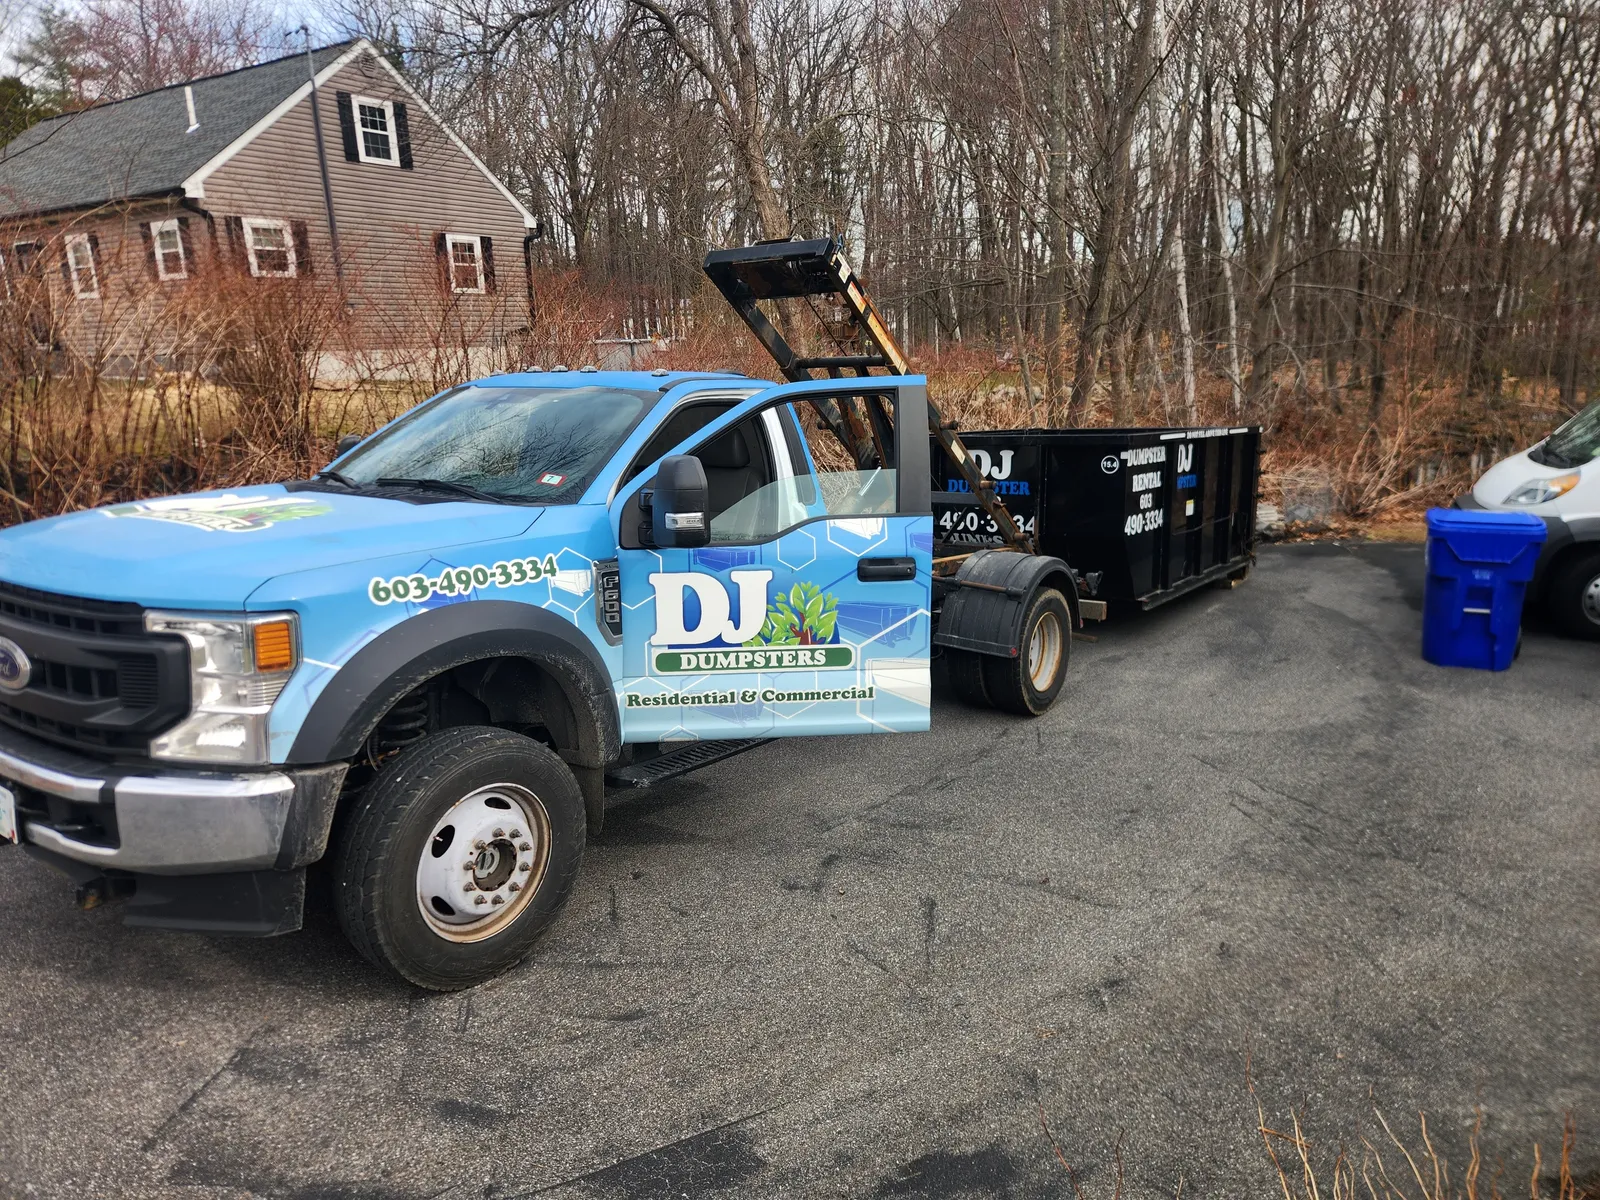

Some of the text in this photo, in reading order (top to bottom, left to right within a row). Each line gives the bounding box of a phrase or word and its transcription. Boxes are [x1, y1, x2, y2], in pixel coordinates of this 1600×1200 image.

[1127, 446, 1166, 467] DUMPSTER
[1177, 443, 1193, 473] DJ
[947, 479, 1030, 495] DUSTER
[1132, 471, 1162, 492] RENTAL
[1140, 493, 1152, 509] 603
[370, 554, 559, 604] 603-490-3334
[649, 570, 773, 646] DJ
[679, 650, 827, 670] DUMPSTERS
[626, 686, 875, 707] Residential & Commercial
